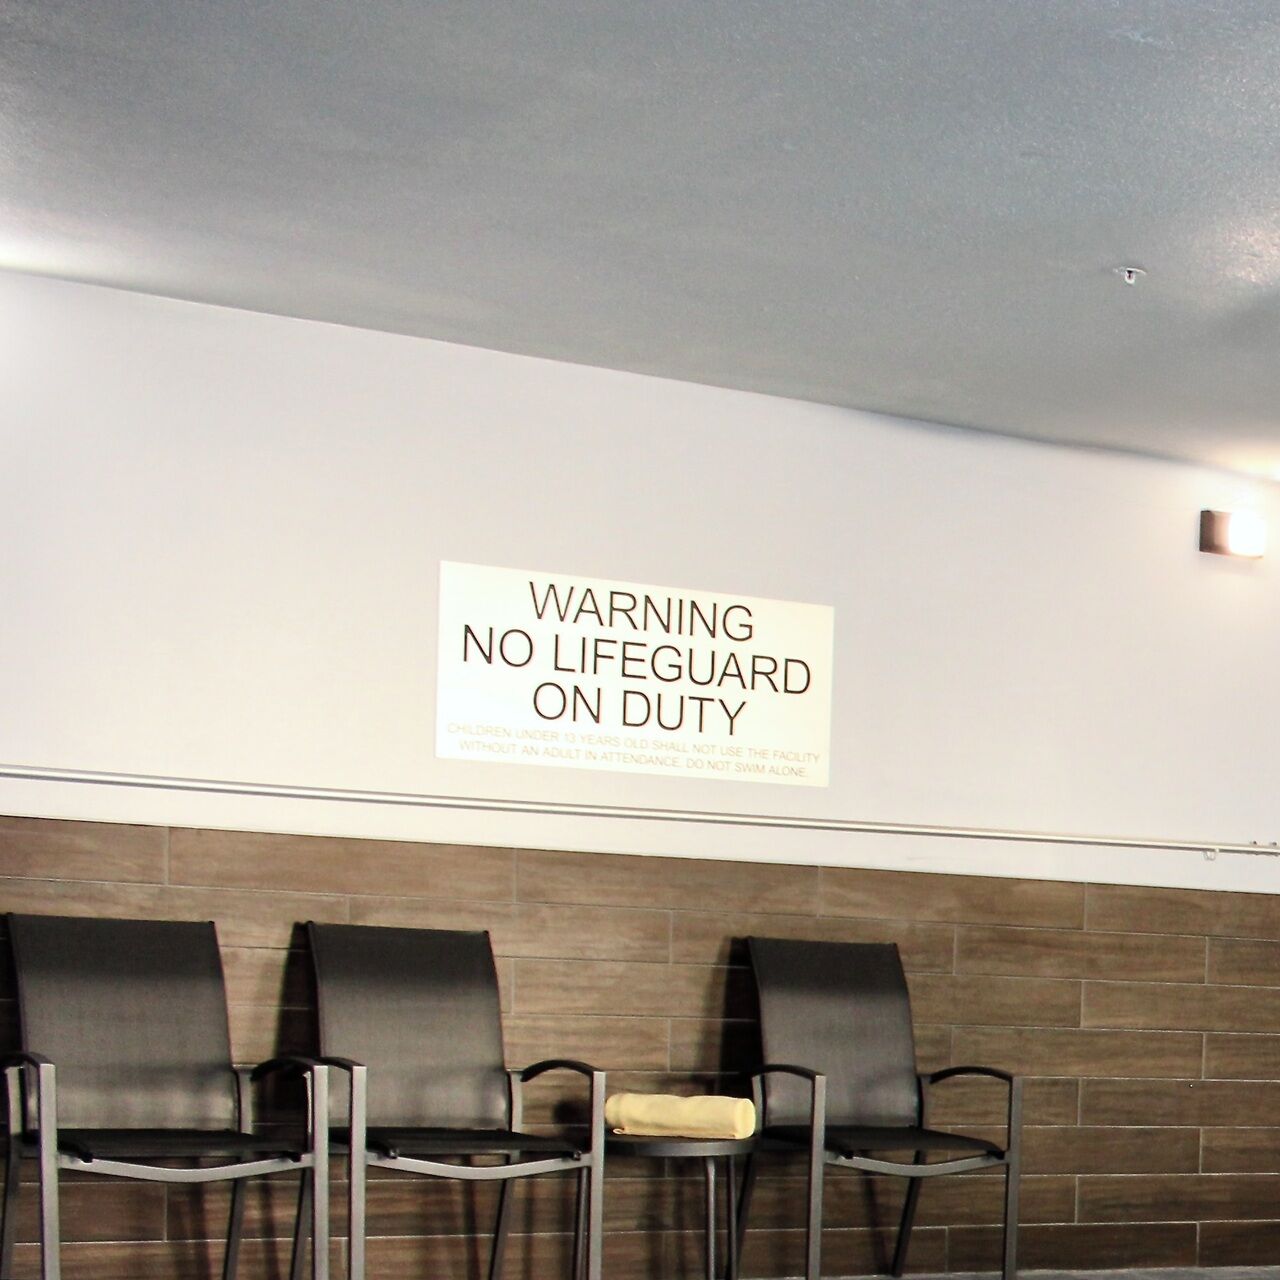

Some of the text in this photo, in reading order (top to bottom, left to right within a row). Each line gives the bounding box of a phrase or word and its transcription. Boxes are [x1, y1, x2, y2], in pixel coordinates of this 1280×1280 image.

[529, 581, 753, 642] WARNING
[463, 624, 811, 695] NO LIFEGUARD
[532, 682, 747, 736] ON DUTY
[447, 722, 512, 738] CHILDREN
[516, 728, 560, 742] UNDER
[579, 734, 621, 747] YEARS
[624, 738, 648, 749] OLD
[653, 740, 689, 753] SHALL
[692, 743, 717, 755] NOT
[720, 746, 743, 757] USE
[747, 748, 769, 759] THE
[773, 750, 821, 764] FACILITY
[459, 739, 517, 754] WITHOUT
[522, 744, 540, 757] AN
[543, 746, 581, 760] ADULT
[585, 749, 597, 761] IN
[686, 757, 704, 769] DO
[708, 760, 732, 772] NOT
[735, 762, 766, 775] SWIM
